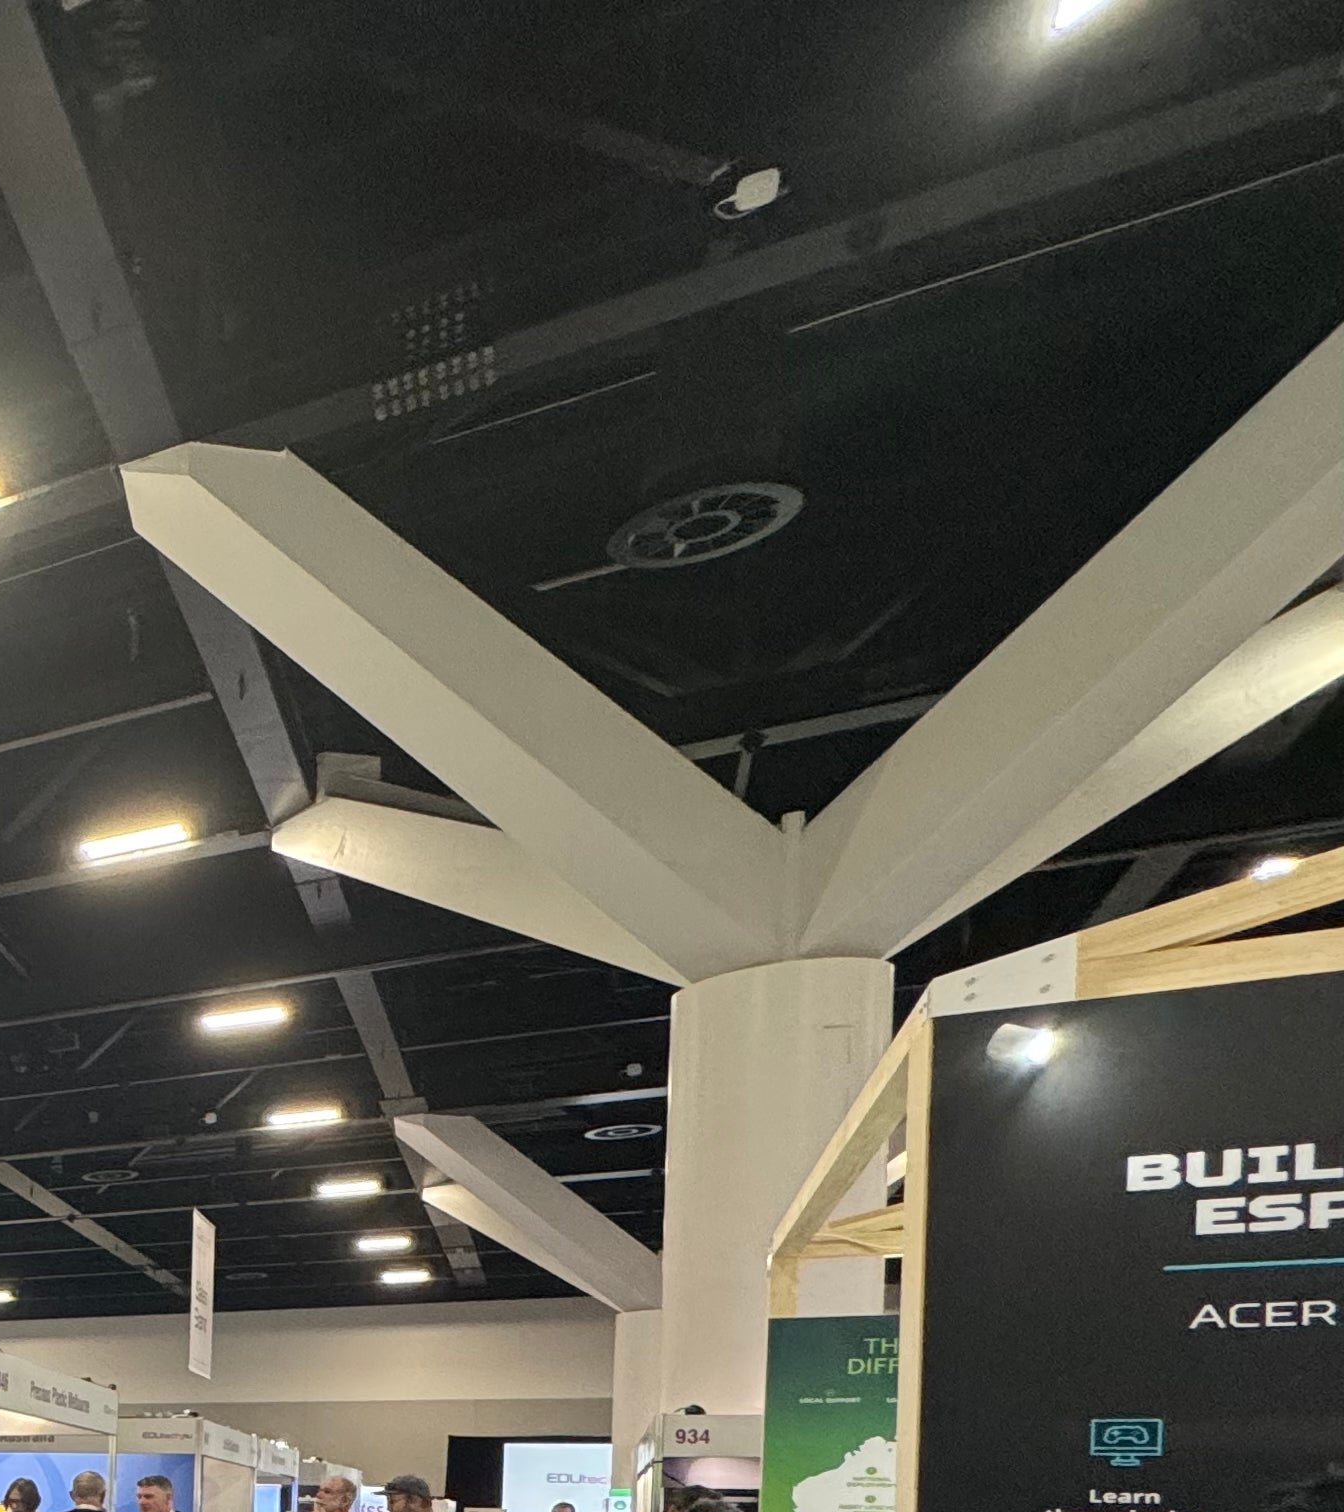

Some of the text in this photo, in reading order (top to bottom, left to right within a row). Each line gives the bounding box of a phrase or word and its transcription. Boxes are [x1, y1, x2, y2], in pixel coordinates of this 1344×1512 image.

[1126, 1143, 1344, 1192] BUIL
[1188, 1300, 1338, 1330] ACER
[675, 1428, 710, 1445] 934
[1089, 1488, 1161, 1505] Learn
